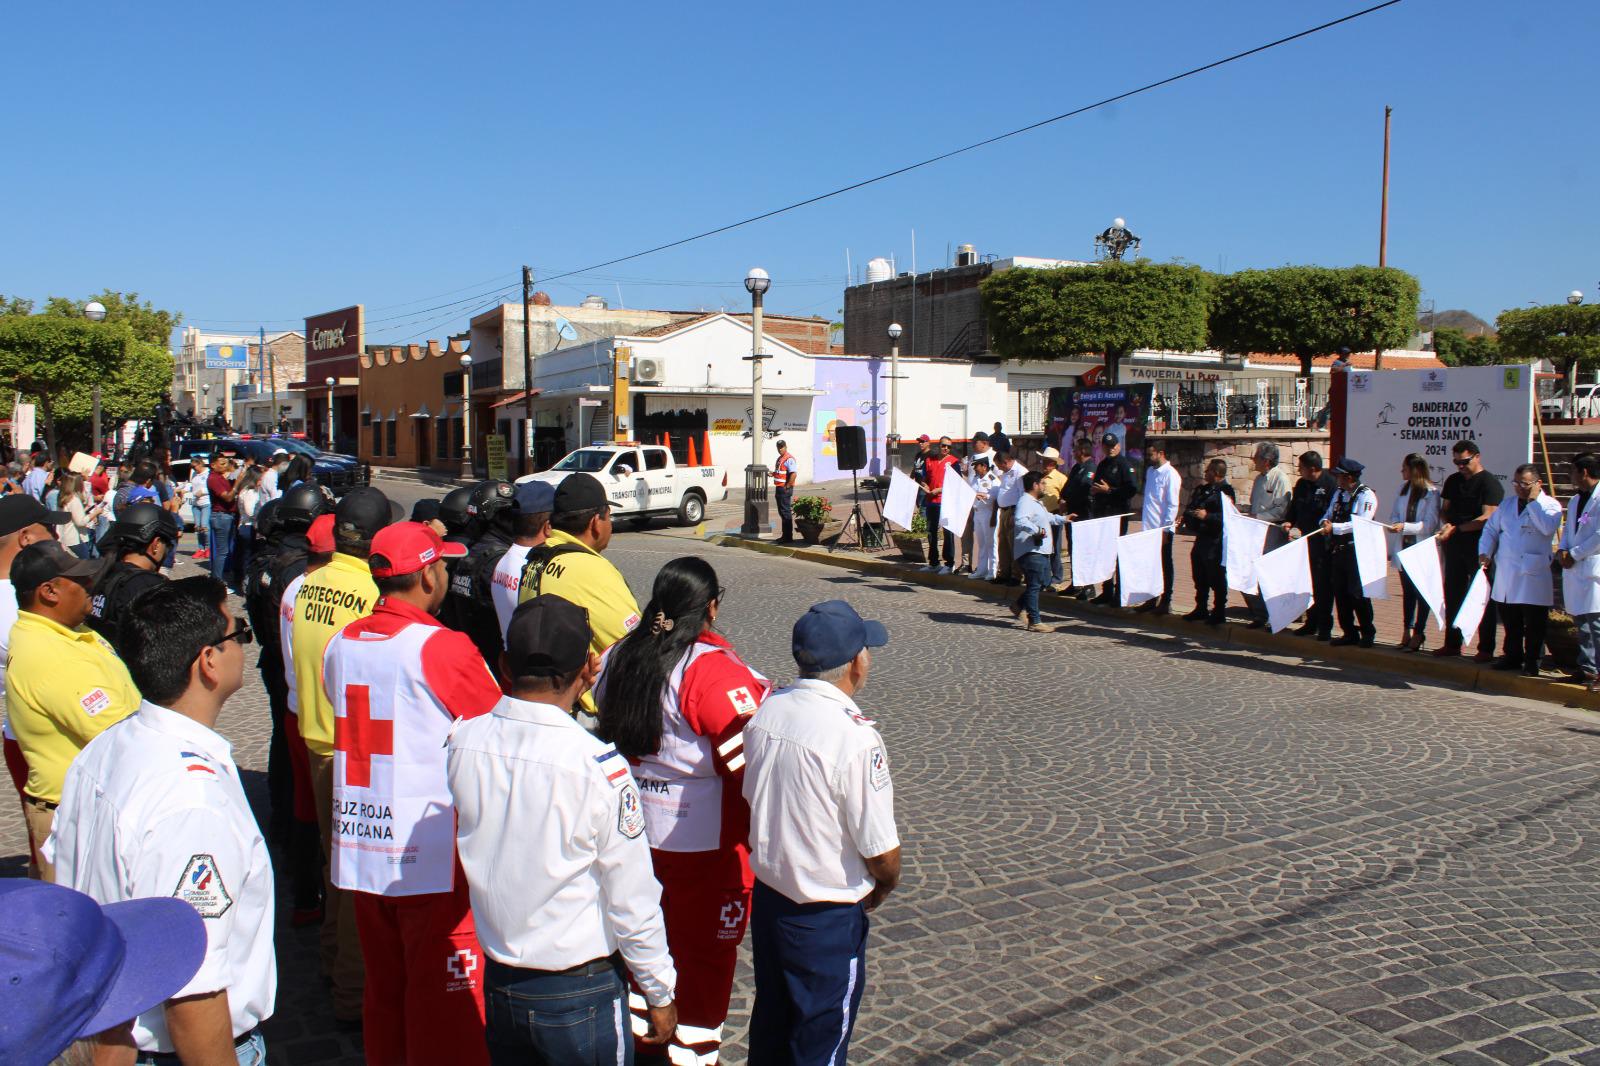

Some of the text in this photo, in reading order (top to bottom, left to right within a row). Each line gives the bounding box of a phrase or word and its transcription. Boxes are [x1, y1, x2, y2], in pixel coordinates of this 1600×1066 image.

[313, 321, 347, 350] Comex
[207, 360, 247, 368] moderna
[1130, 368, 1182, 379] TAQUERIA
[1412, 401, 1468, 413] BANDERAZO
[1400, 429, 1476, 441] SEMANA SANTA
[1425, 445, 1447, 456] 2024
[647, 486, 672, 496] MUNICIPAL
[305, 602, 335, 626] CIVIL
[360, 803, 393, 820] ROJA
